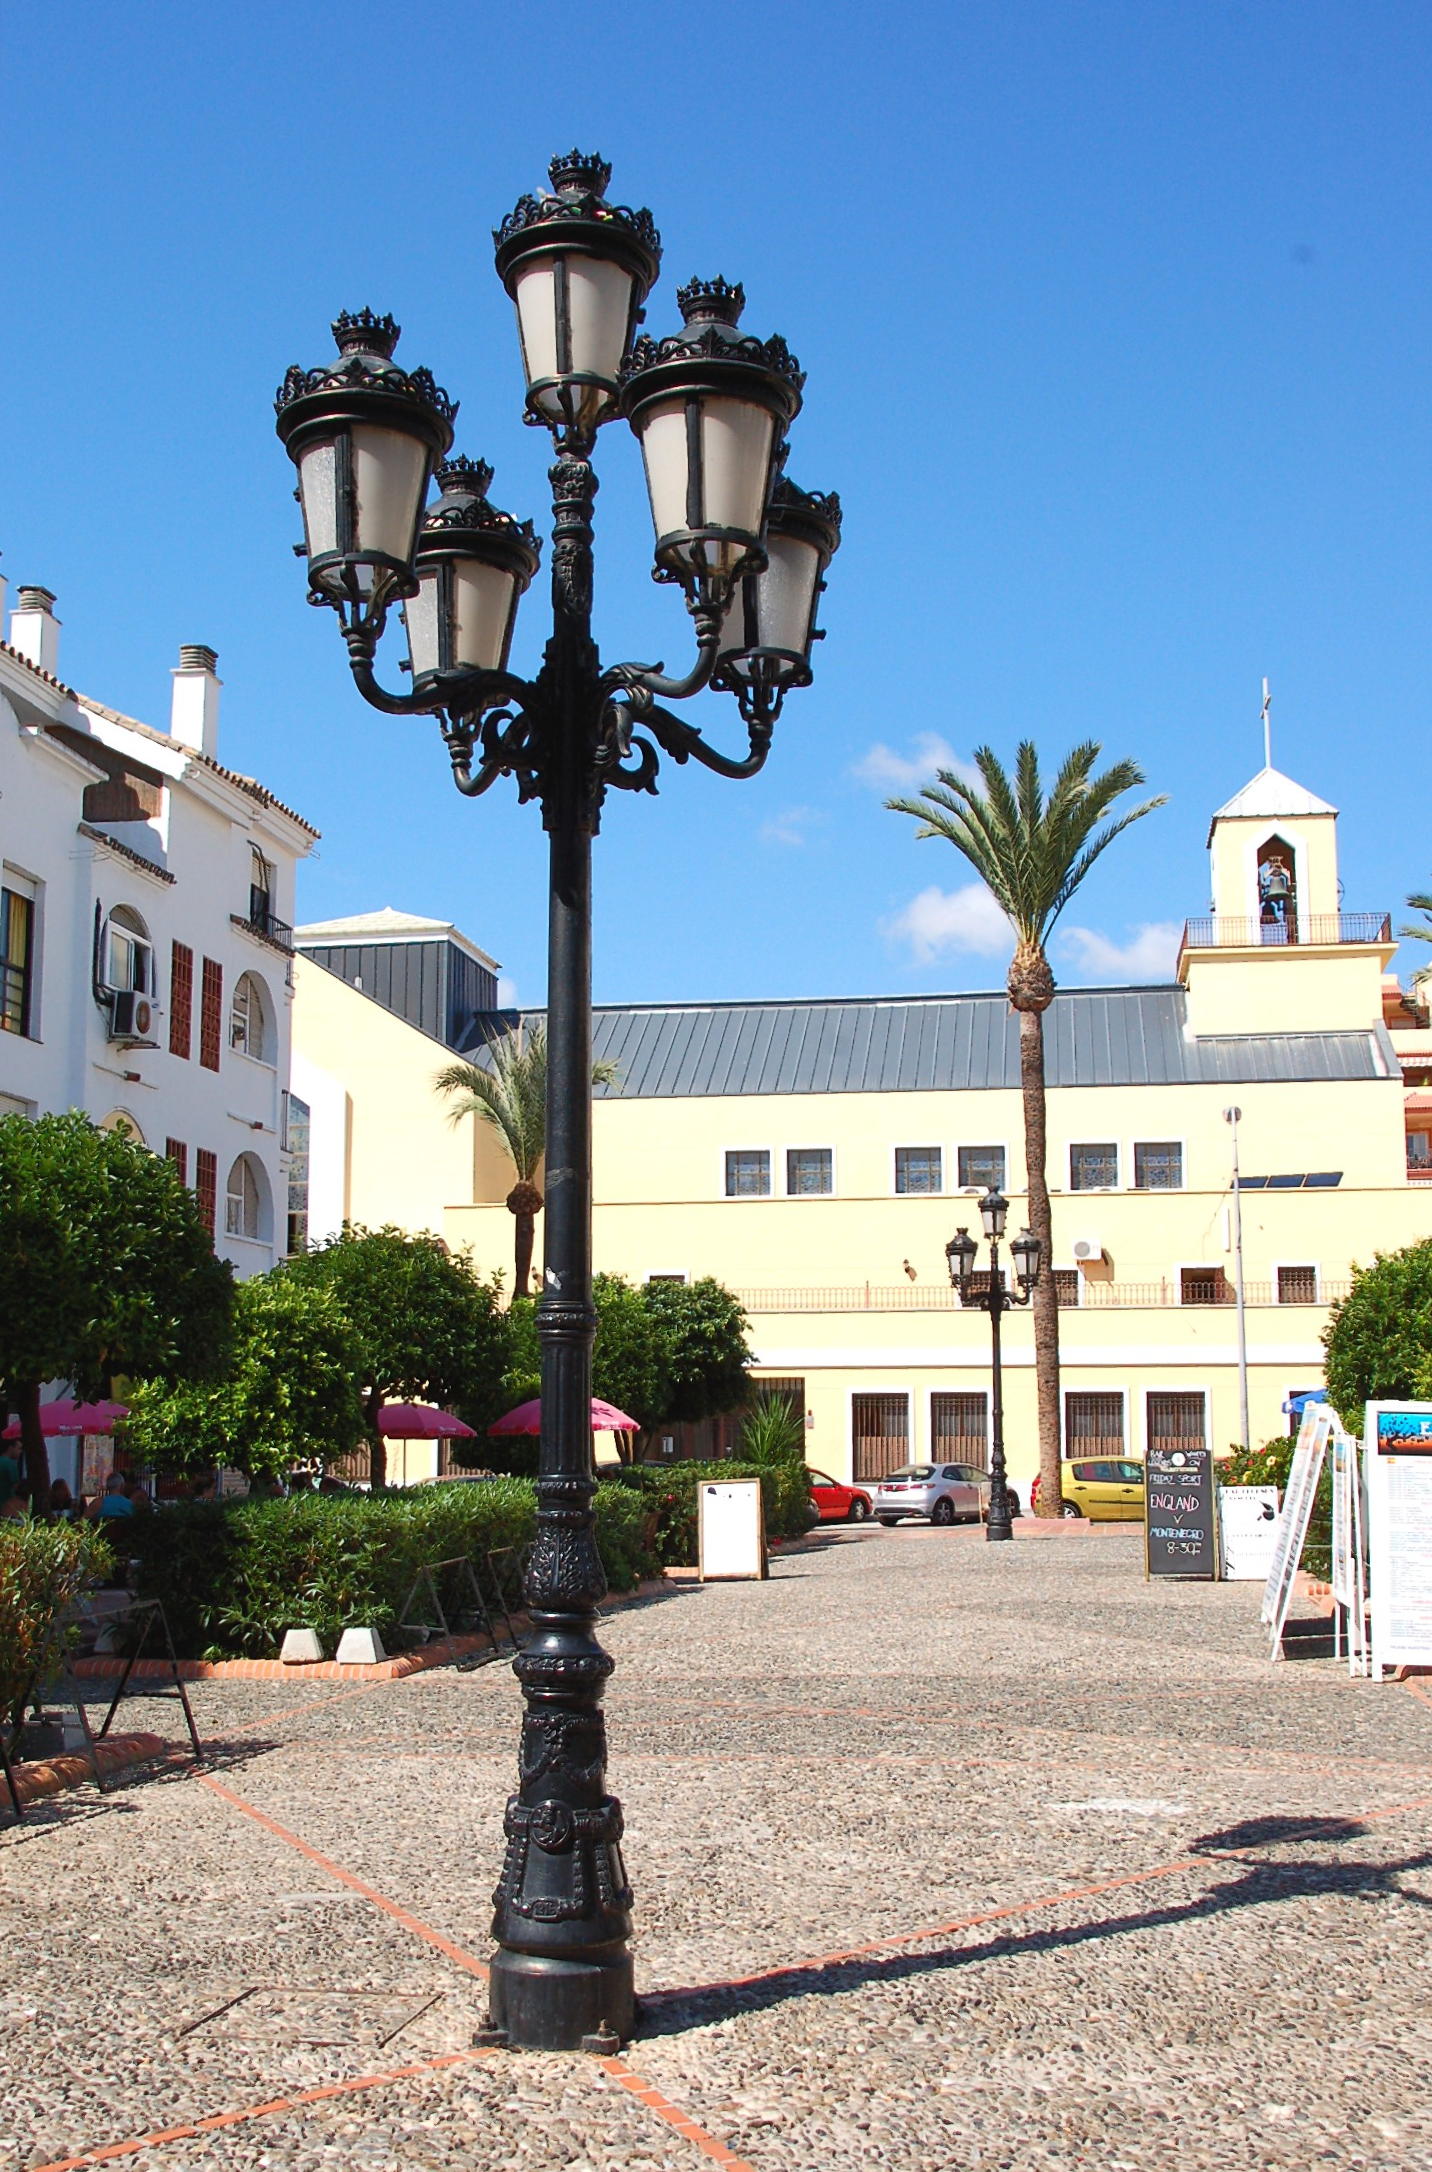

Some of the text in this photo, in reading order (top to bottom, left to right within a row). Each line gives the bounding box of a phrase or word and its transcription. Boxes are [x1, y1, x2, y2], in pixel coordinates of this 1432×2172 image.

[1149, 1474, 1201, 1485] FRIDAY SPORT
[1150, 1493, 1200, 1511] ENGLAND
[1149, 1527, 1204, 1540] MONTENEGRO
